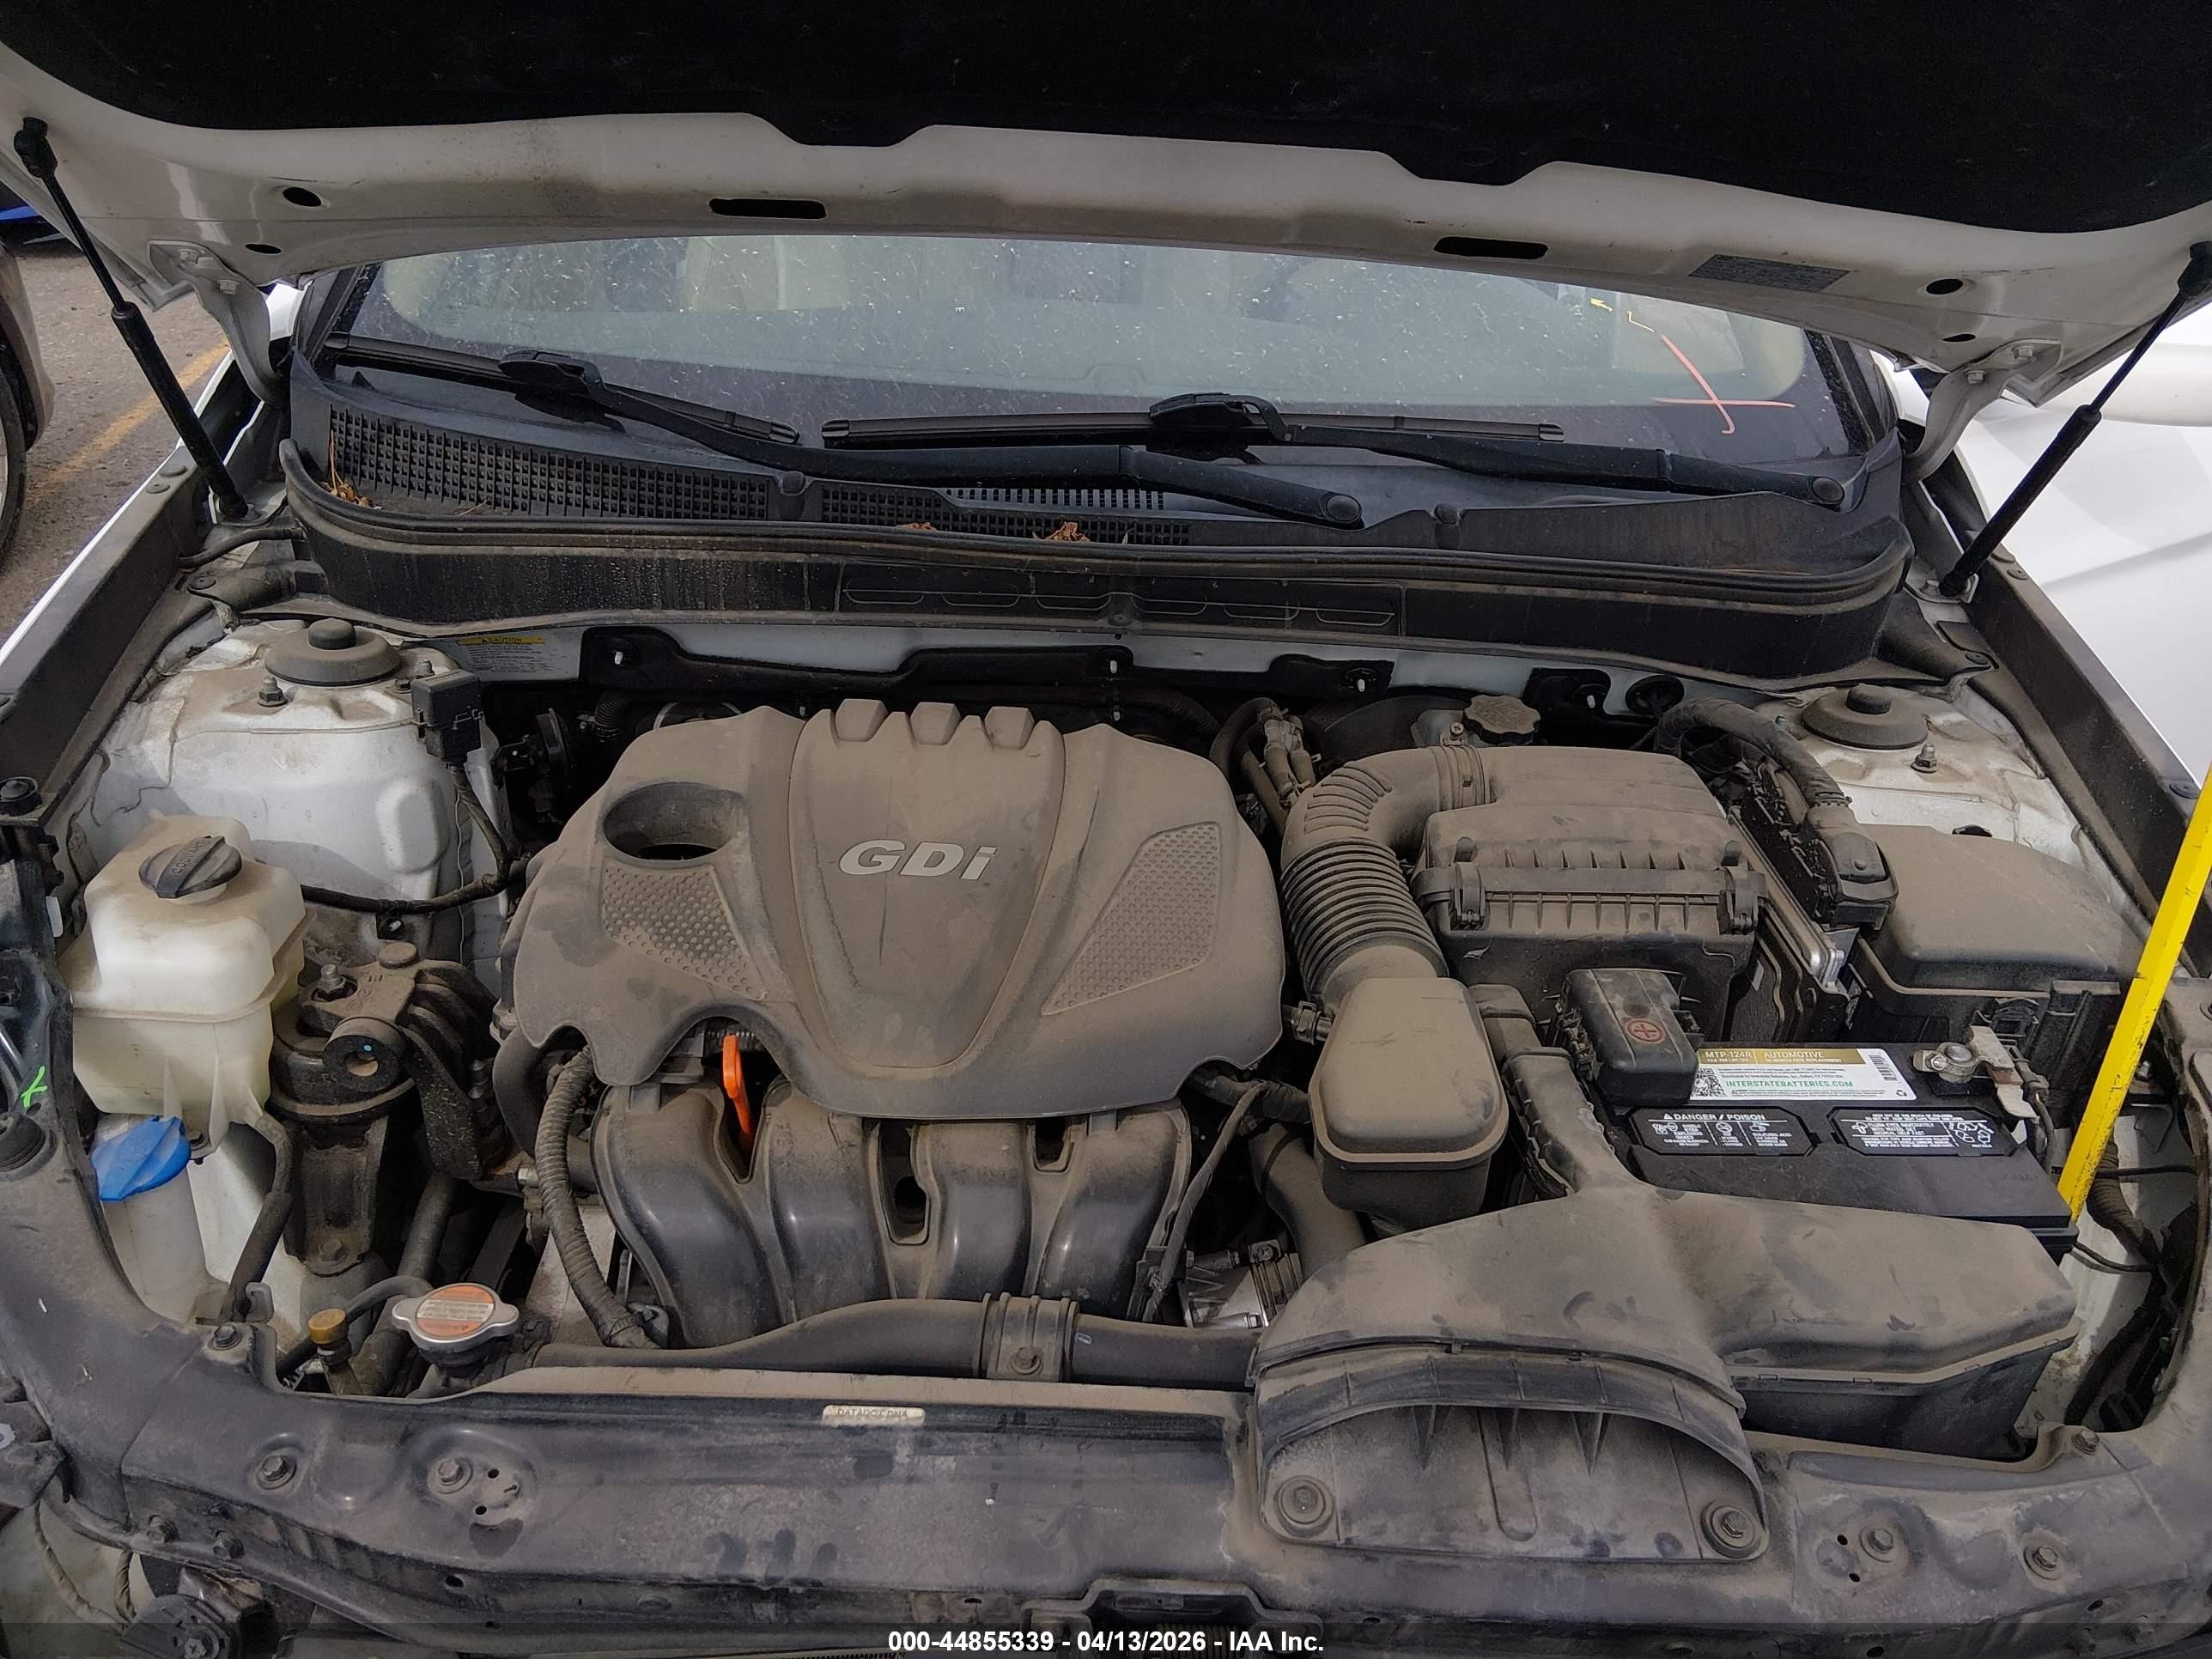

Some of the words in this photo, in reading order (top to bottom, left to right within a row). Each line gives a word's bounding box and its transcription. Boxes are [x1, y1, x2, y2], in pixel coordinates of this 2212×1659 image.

[838, 839, 998, 880] GDi
[837, 1408, 884, 1417] DATADOT
[887, 1409, 908, 1418] DNA
